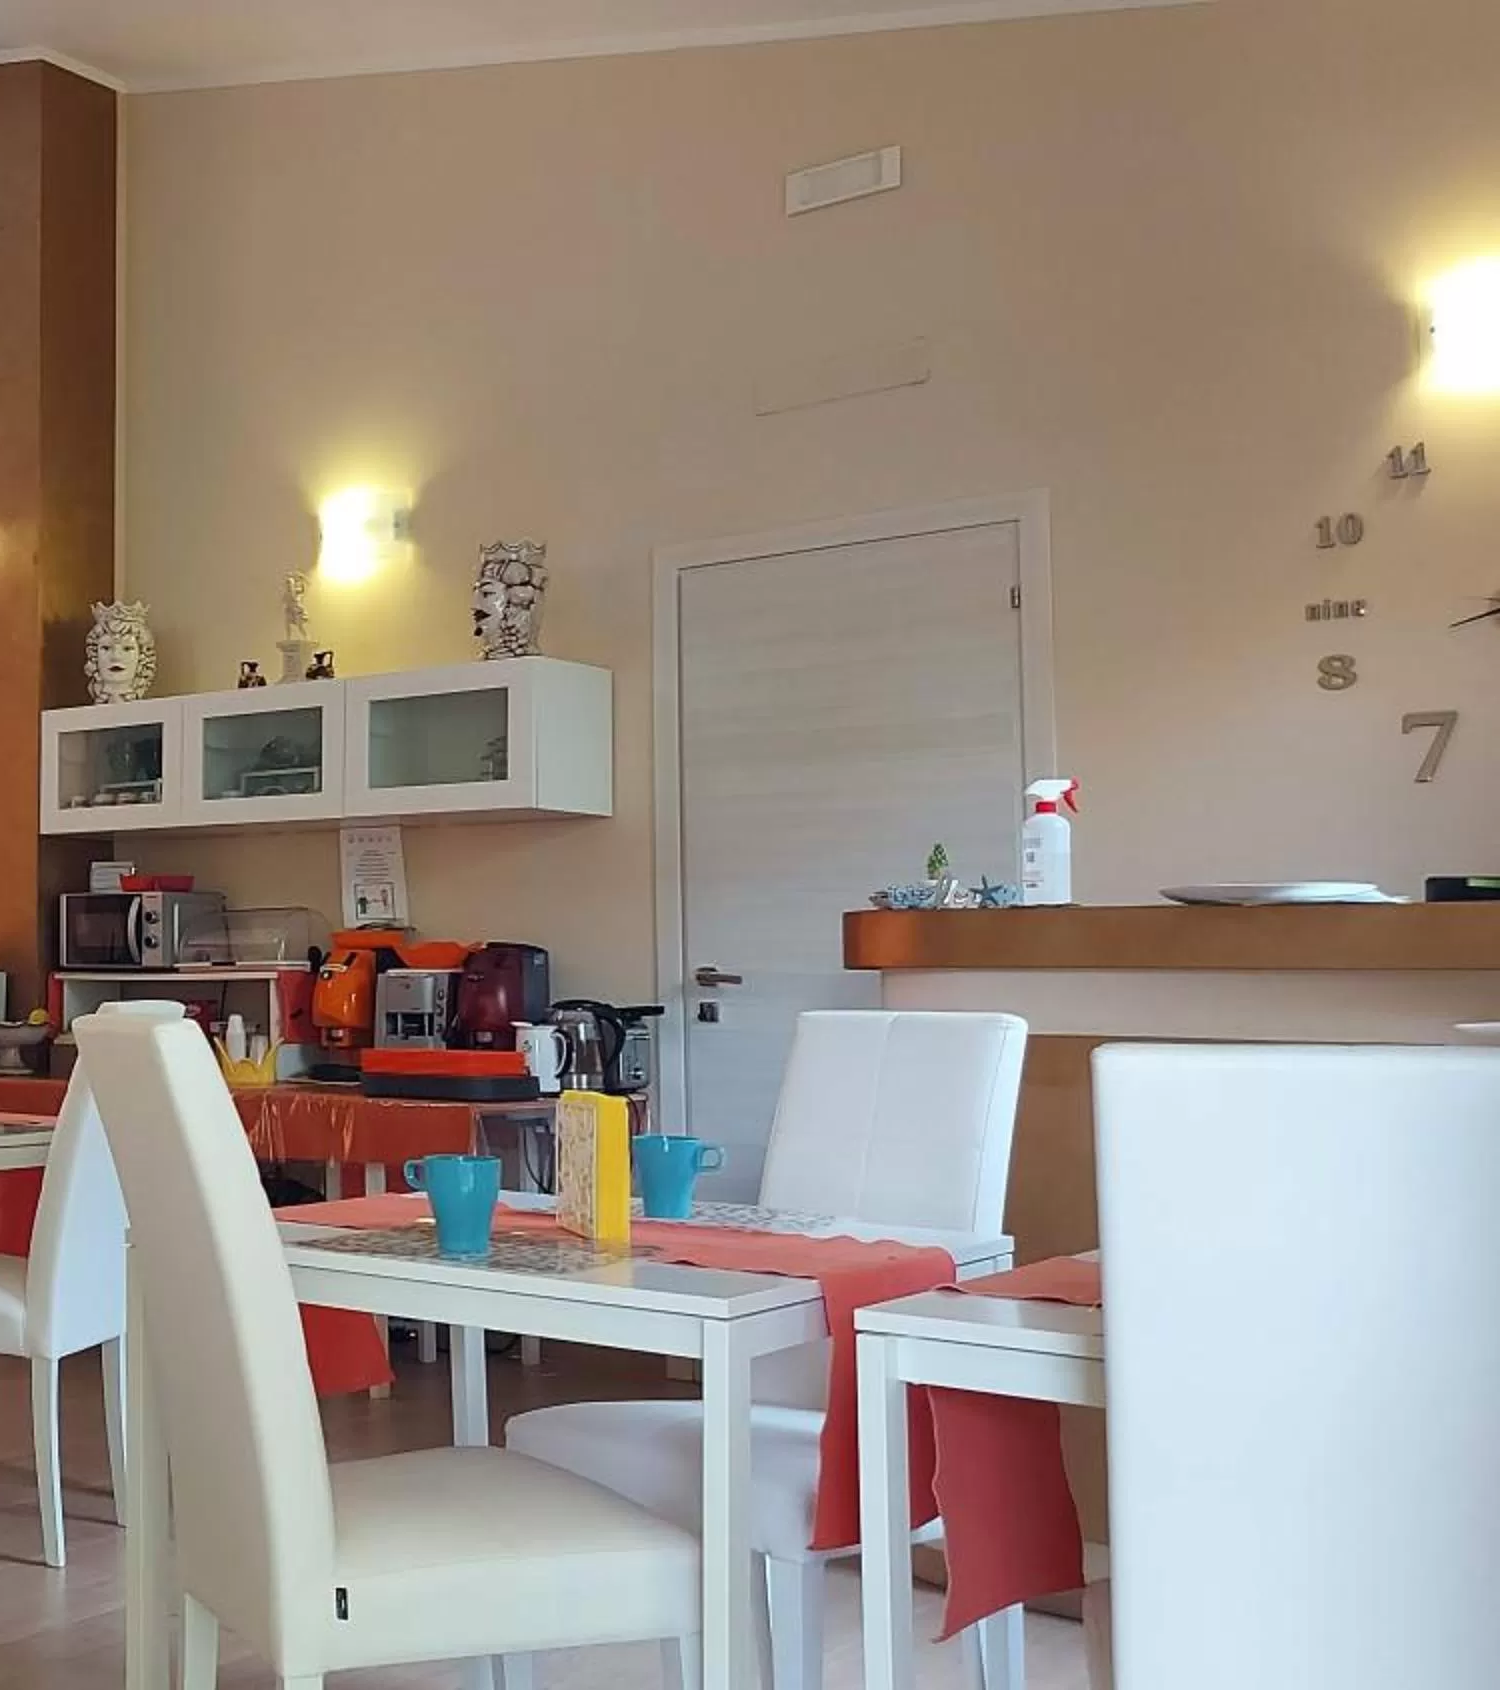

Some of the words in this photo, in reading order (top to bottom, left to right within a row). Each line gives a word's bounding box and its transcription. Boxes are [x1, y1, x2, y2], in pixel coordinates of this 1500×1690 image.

[1386, 442, 1431, 479] 11
[1314, 513, 1364, 549] 10
[1317, 654, 1358, 690] 8
[1401, 710, 1459, 783] 7
